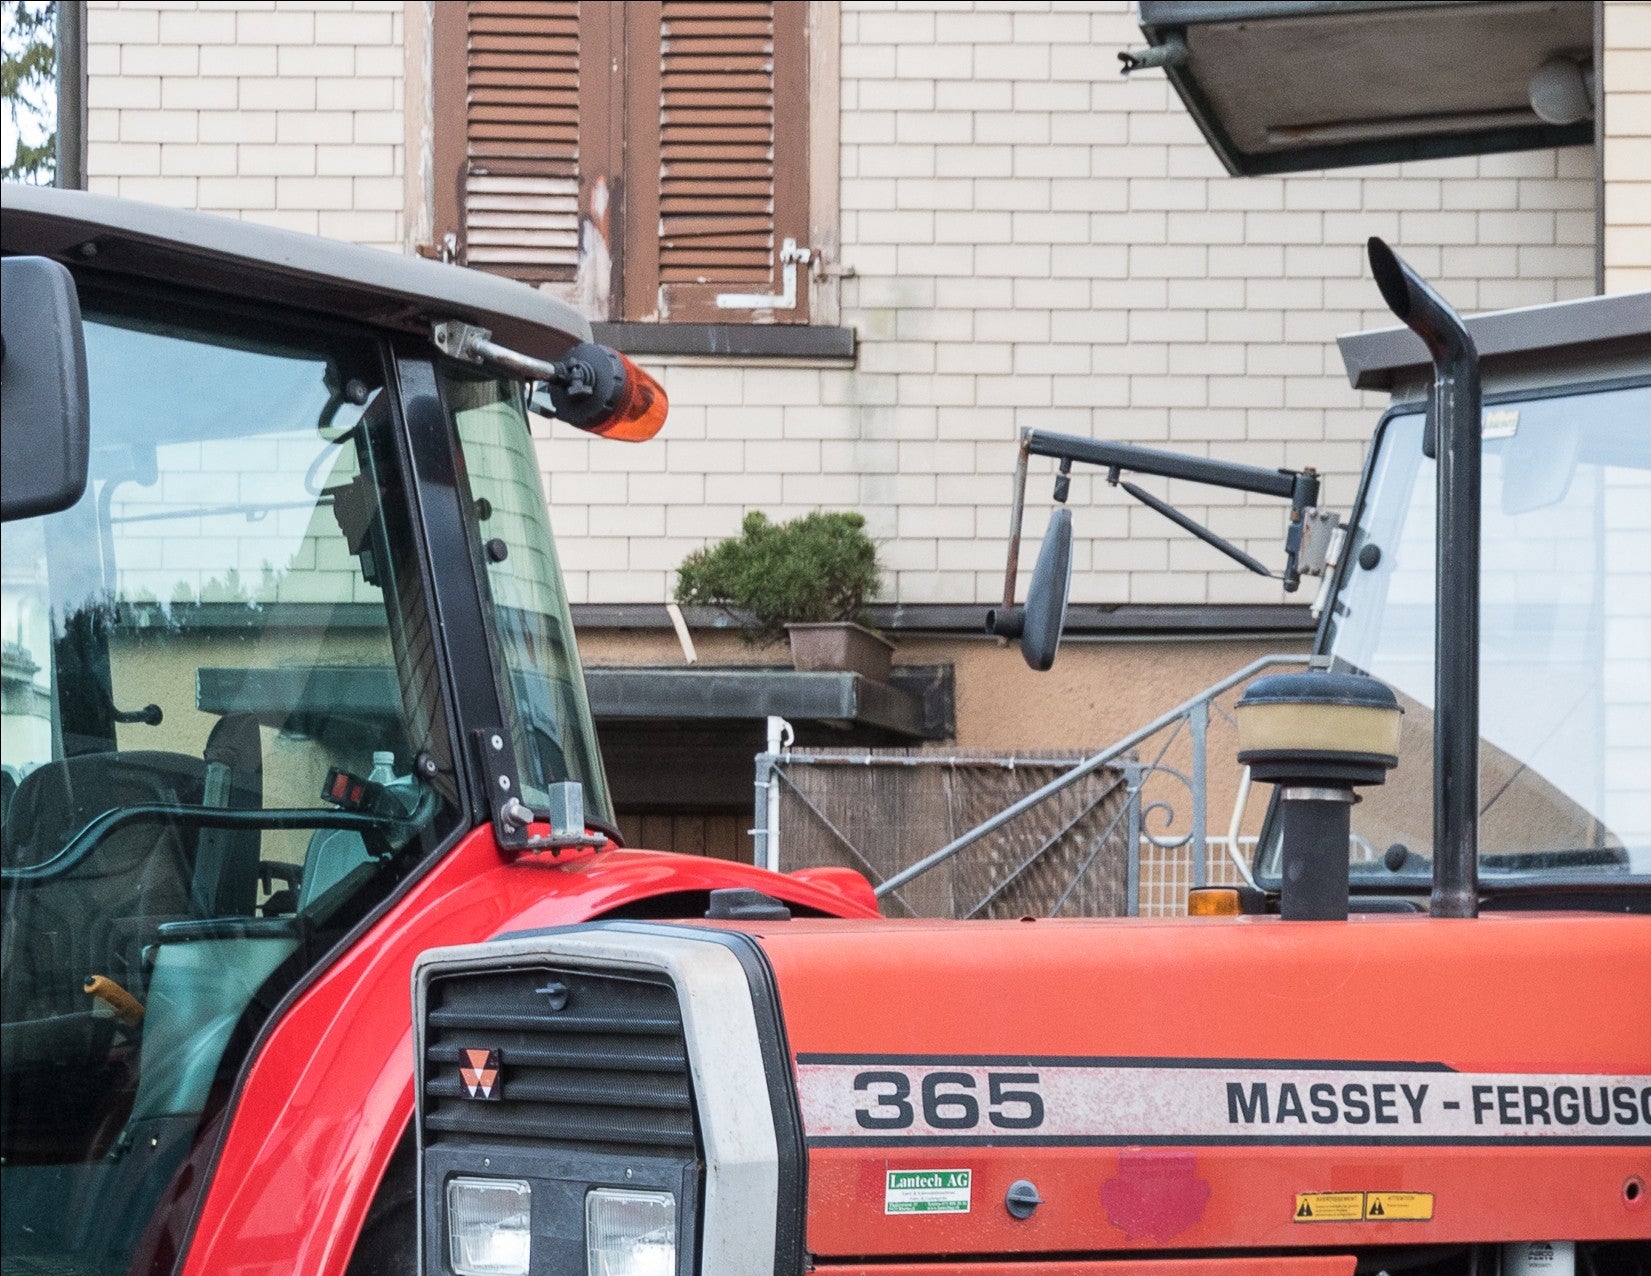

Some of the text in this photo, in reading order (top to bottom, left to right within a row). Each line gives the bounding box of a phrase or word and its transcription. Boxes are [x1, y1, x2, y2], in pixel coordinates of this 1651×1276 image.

[853, 1070, 1045, 1130] 365
[1225, 1081, 1430, 1126] MASSEY
[891, 1173, 968, 1188] Lantech AG
